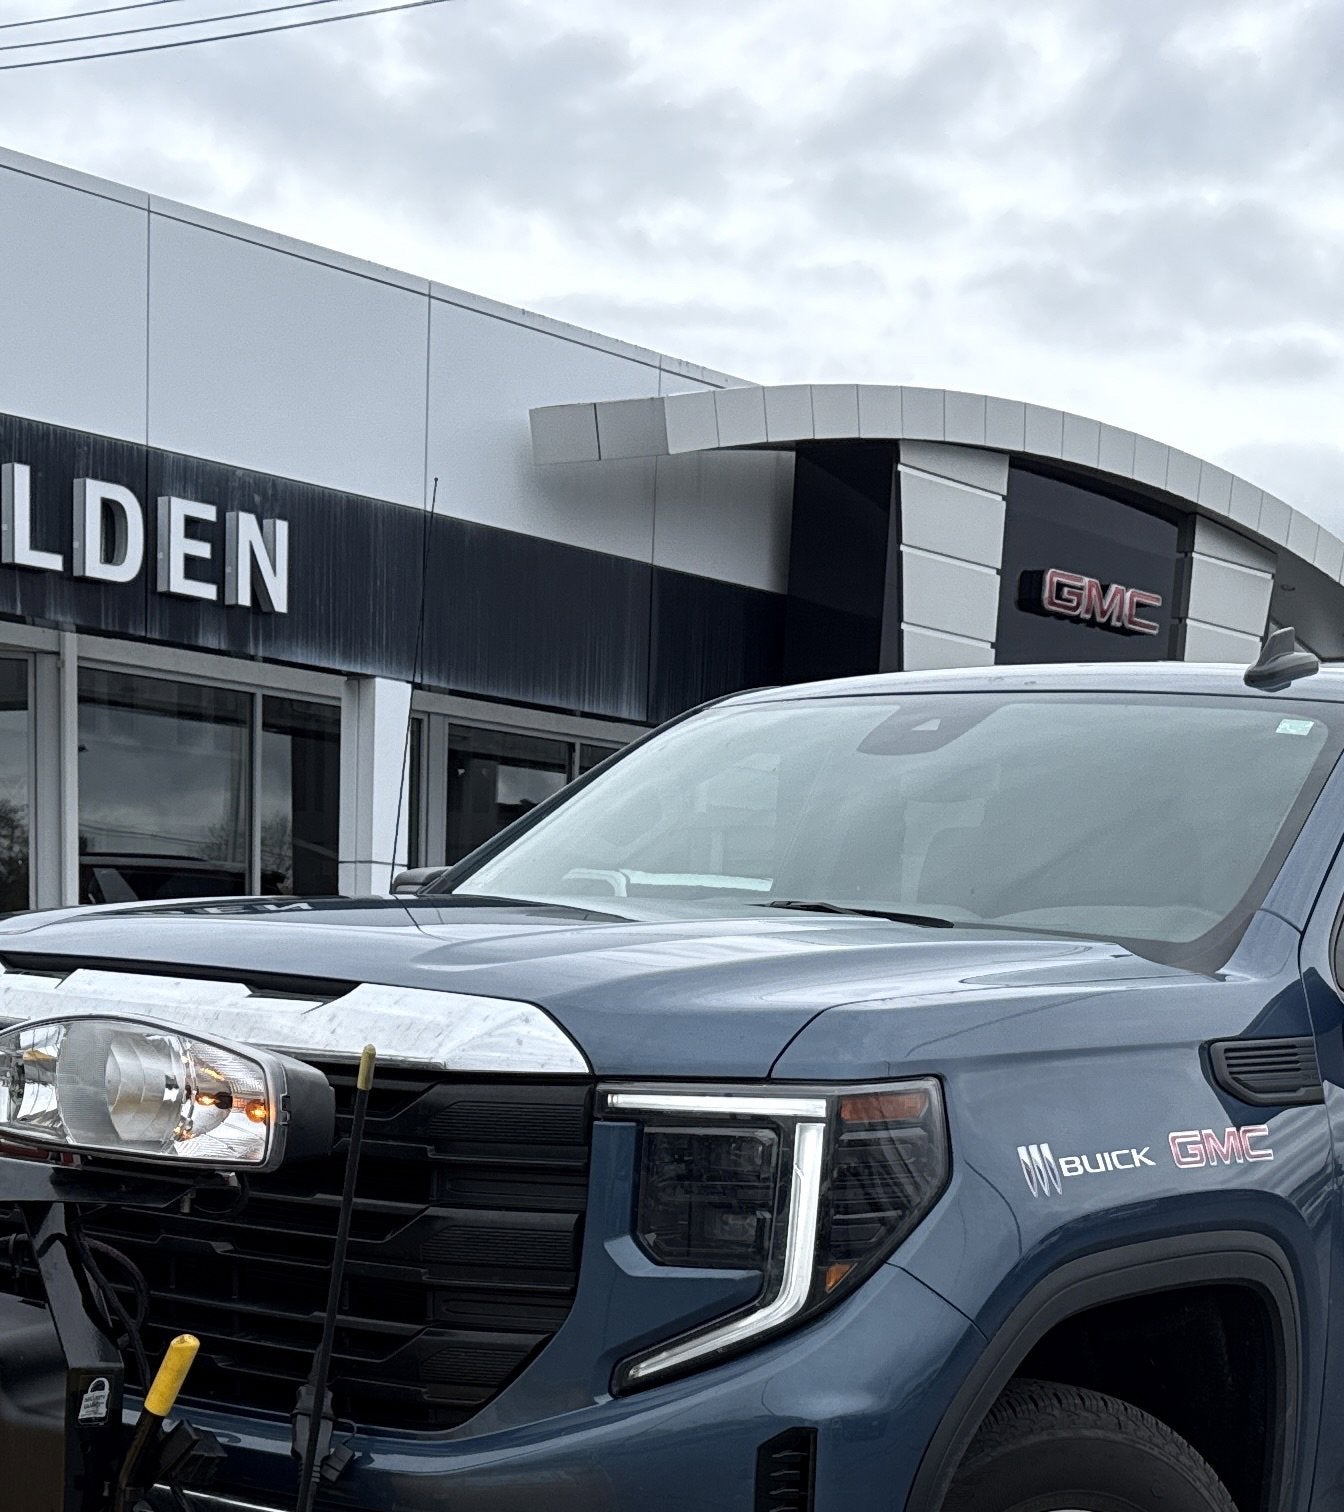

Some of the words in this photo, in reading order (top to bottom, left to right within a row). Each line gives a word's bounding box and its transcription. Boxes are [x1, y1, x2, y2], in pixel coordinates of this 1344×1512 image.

[1042, 568, 1163, 636] GMC
[1058, 1146, 1156, 1178] BUICK
[1167, 1124, 1274, 1169] GMC
